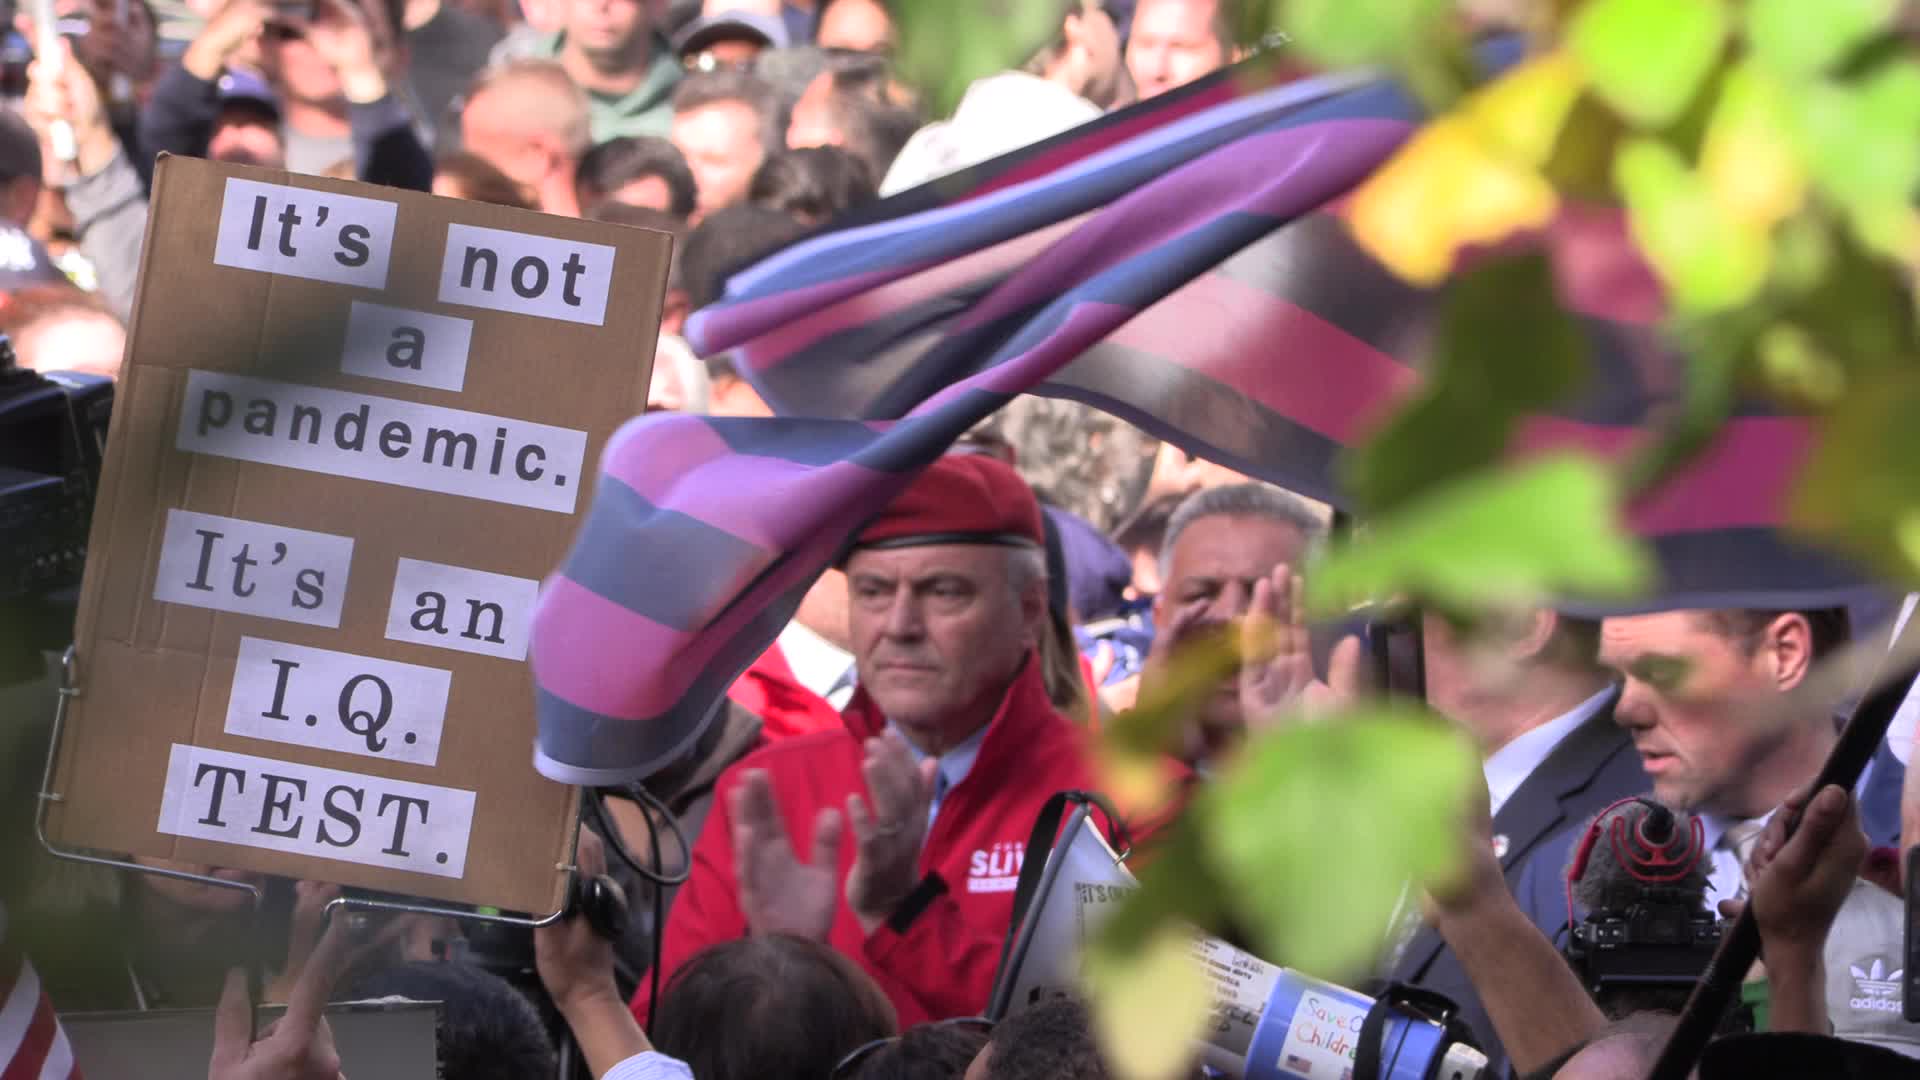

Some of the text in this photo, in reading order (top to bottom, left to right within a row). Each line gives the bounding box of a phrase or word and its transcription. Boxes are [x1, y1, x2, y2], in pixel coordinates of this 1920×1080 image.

[247, 196, 586, 306] It's not
[386, 326, 425, 369] a
[198, 388, 567, 487] pandemic.
[186, 530, 505, 644] It's an
[261, 659, 417, 752] I.Q.
[194, 763, 449, 865] TEST.
[1296, 1022, 1357, 1059] Childre
[1306, 997, 1345, 1029] Save
